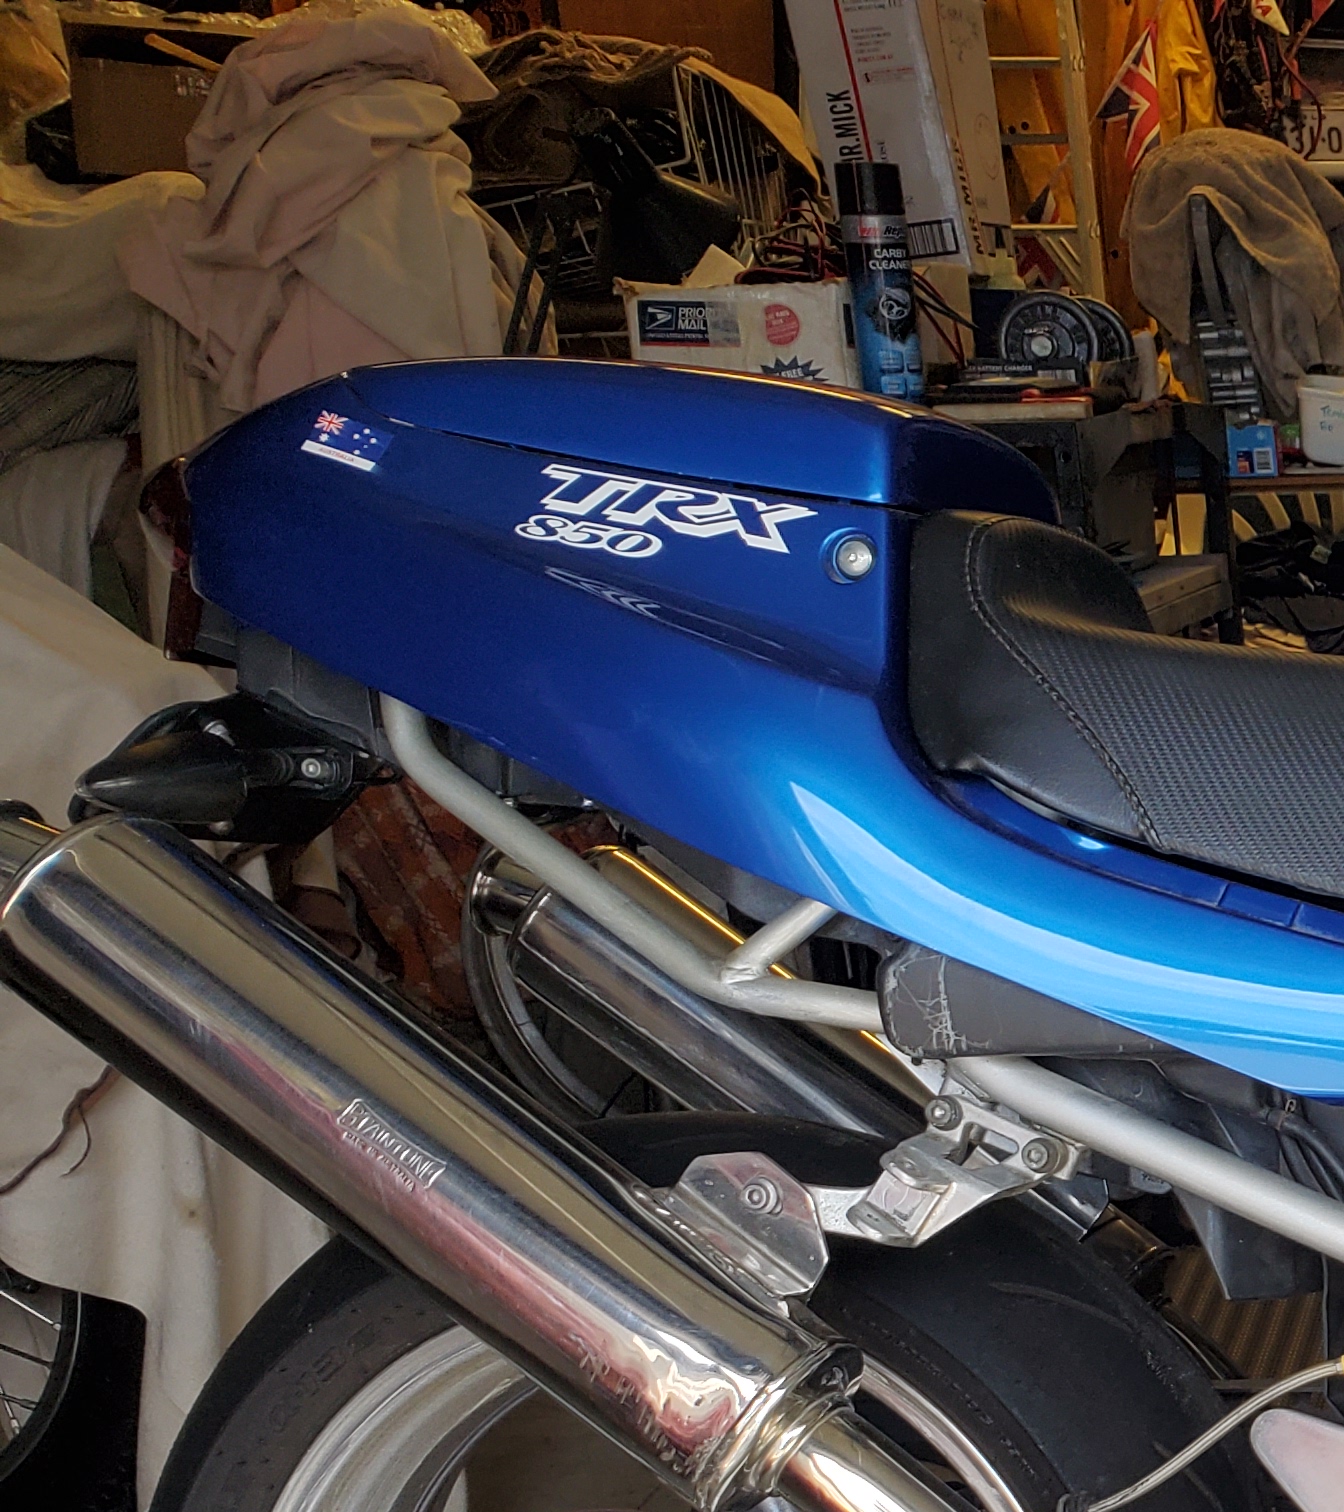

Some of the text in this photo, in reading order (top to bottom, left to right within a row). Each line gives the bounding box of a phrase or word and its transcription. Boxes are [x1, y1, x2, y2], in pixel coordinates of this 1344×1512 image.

[826, 89, 864, 162] R.MICK
[868, 259, 909, 271] CLEANE
[873, 248, 907, 259] CARBY
[677, 319, 707, 331] MAIL
[541, 463, 819, 554] TRX
[514, 514, 663, 558] 850
